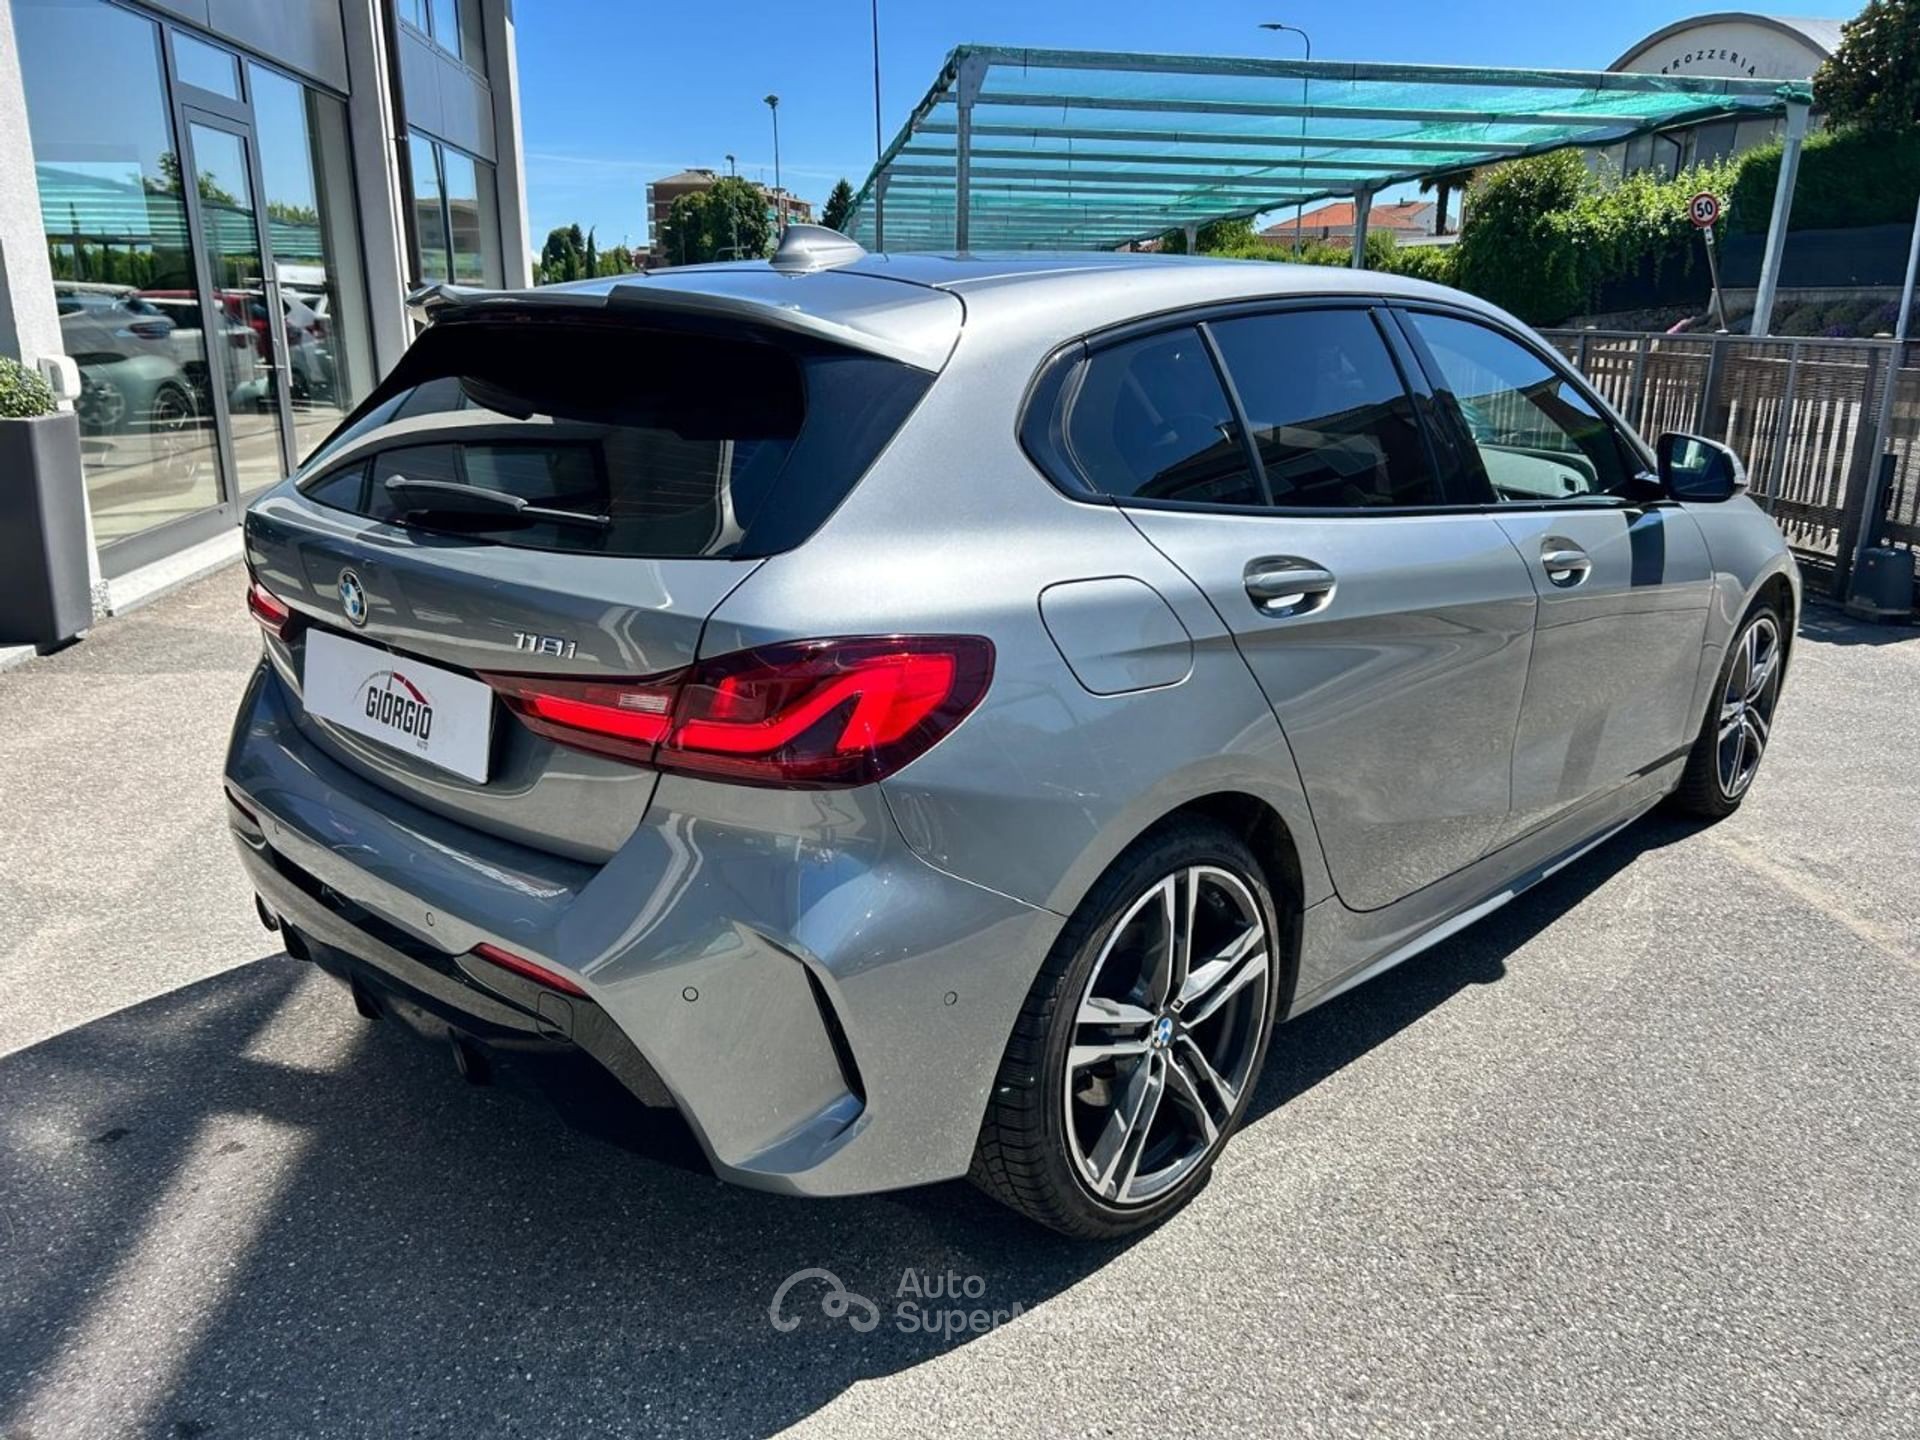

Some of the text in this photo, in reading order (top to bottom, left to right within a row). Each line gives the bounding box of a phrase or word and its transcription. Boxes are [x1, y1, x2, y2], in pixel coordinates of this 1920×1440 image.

[1697, 200, 1713, 218] 50
[512, 631, 578, 660] 118i
[366, 686, 433, 740] GIORGIO
